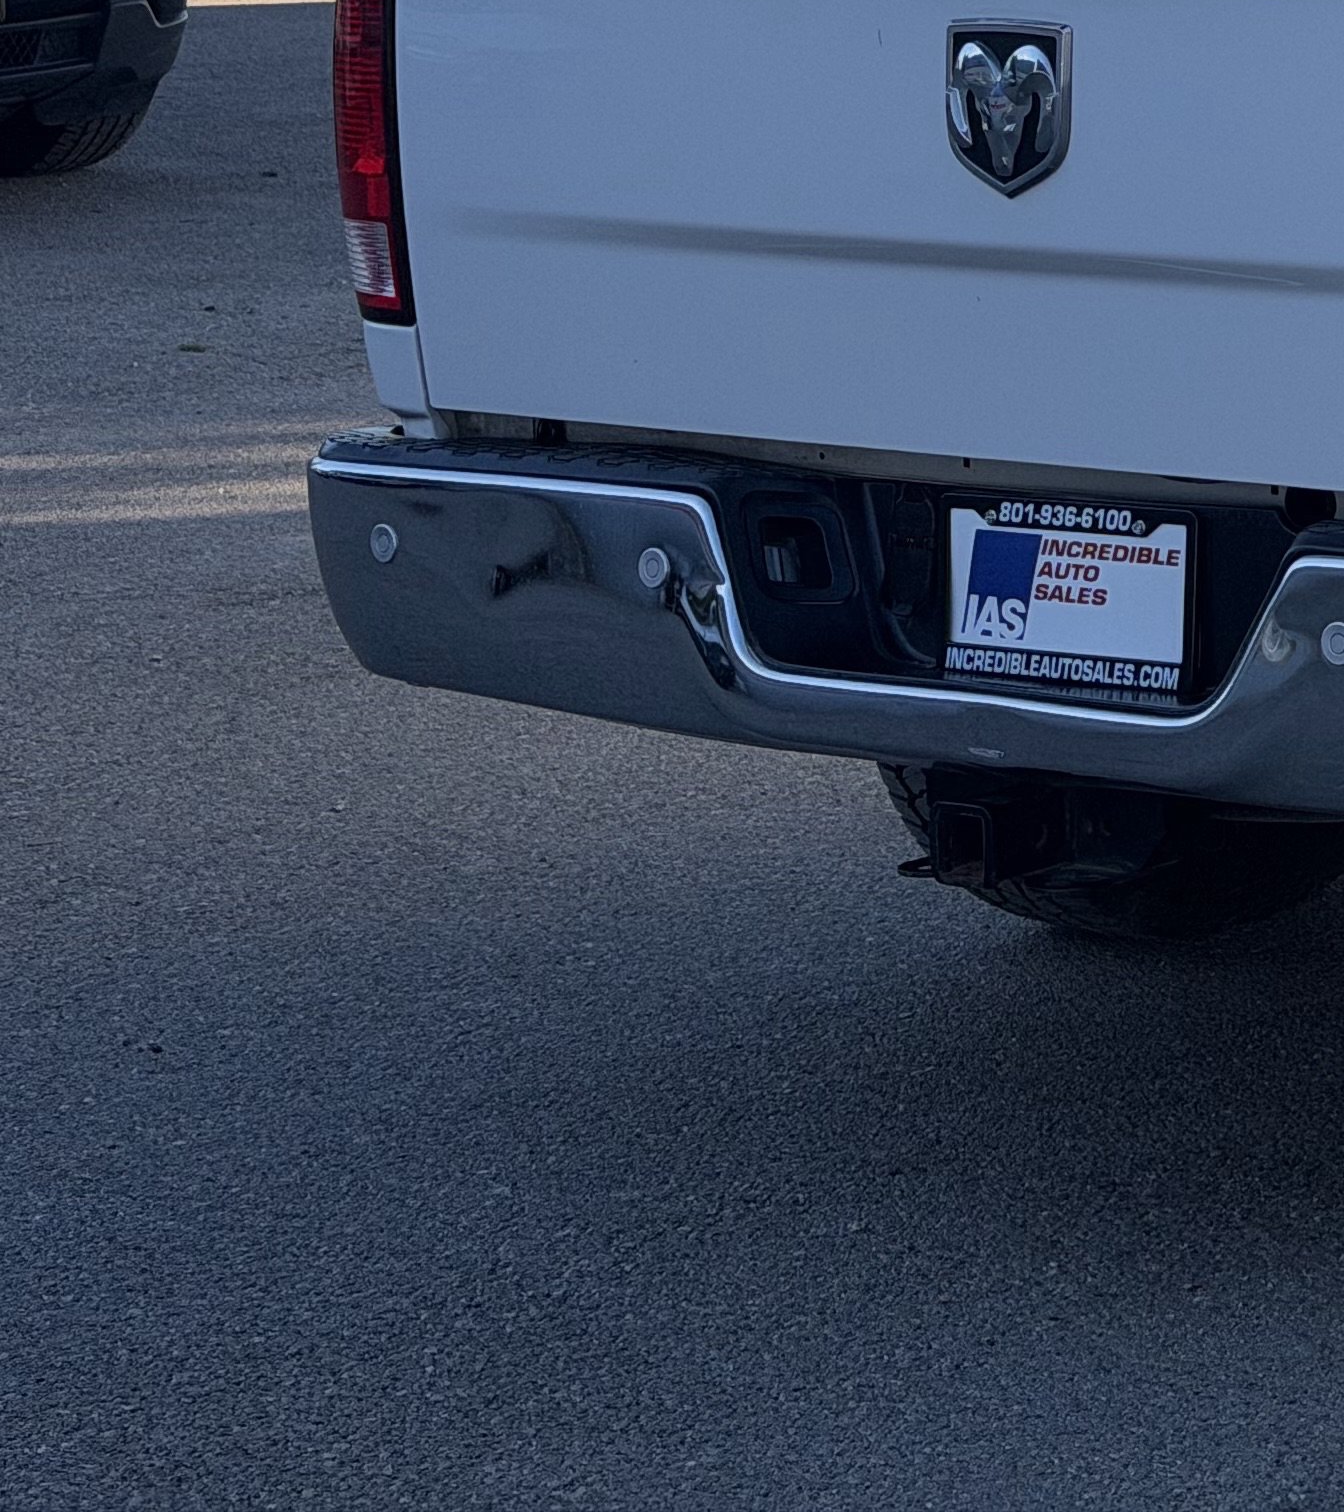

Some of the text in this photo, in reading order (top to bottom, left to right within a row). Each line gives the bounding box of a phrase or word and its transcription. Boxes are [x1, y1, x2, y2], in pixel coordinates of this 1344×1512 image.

[999, 501, 1132, 532] 801-936-6100
[1040, 538, 1182, 567] INCREDIBLE
[1037, 561, 1101, 583] AUTO
[1033, 584, 1108, 606] SALES
[963, 594, 1027, 639] IAS
[945, 647, 1180, 690] INCREDIBLEAUTOSALES.COM
